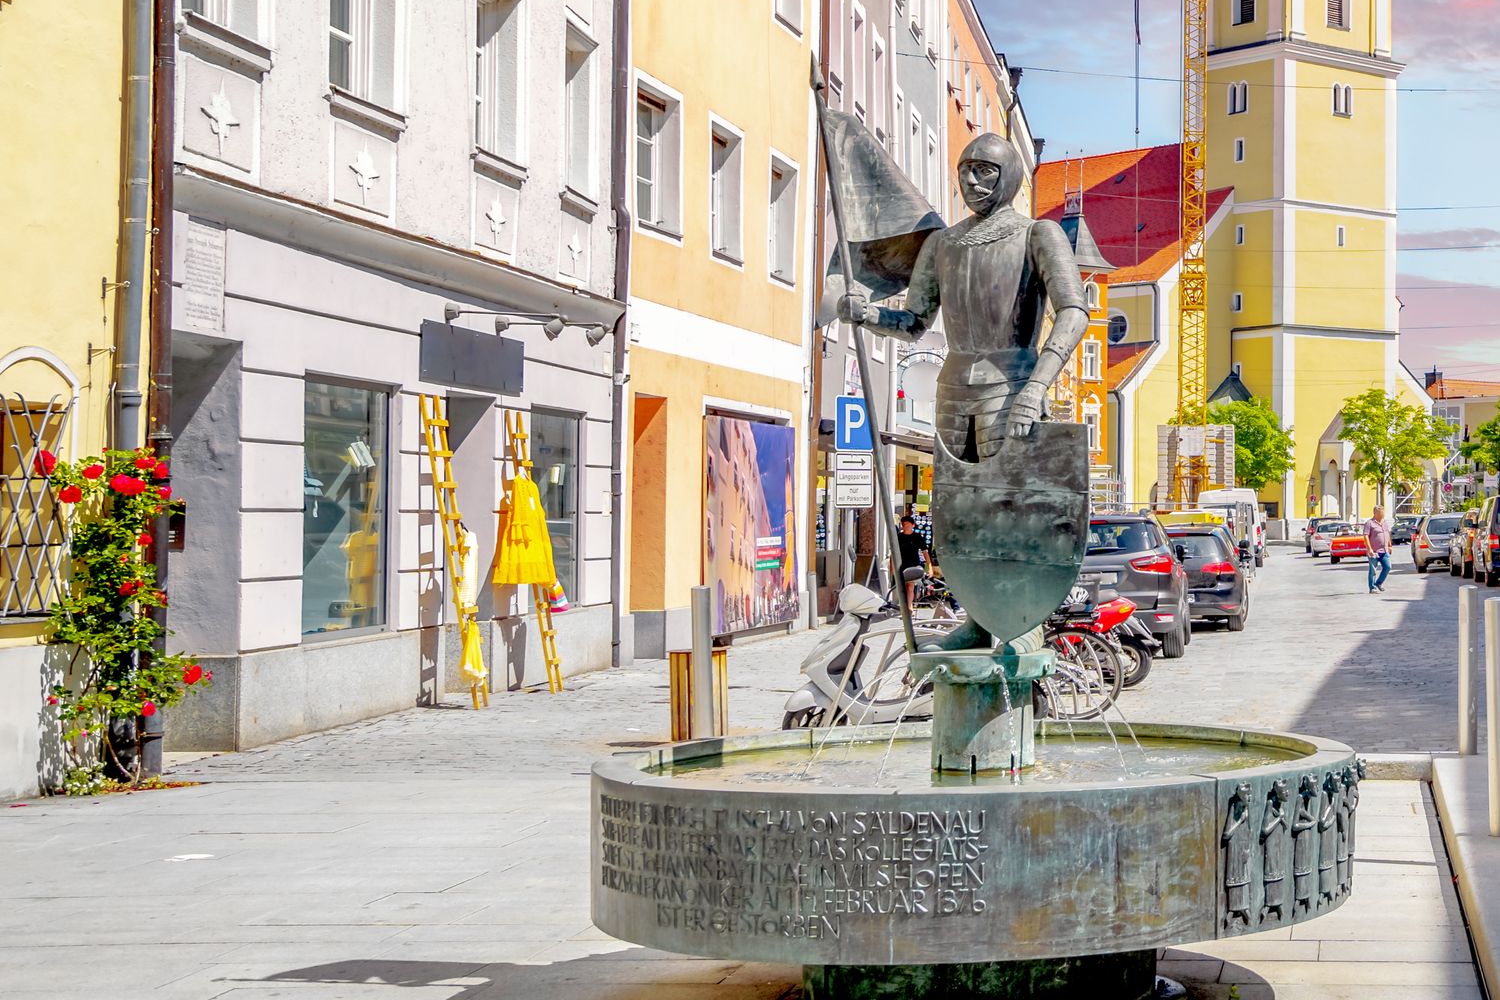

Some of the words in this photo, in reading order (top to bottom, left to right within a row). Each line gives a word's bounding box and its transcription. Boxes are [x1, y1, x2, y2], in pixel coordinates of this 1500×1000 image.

[845, 403, 866, 444] P
[797, 810, 847, 835] VON
[852, 809, 987, 835] SÄLDENAU
[809, 837, 848, 861] DAS
[852, 836, 989, 862] KOLLEGIATS-
[813, 863, 837, 887] IN
[841, 862, 986, 888] VILSHOFEN
[652, 877, 755, 911] KANONIKER
[760, 886, 793, 912] AM
[824, 888, 929, 914] FEBRUAR
[936, 888, 987, 914] 1376
[657, 904, 683, 929] IST
[683, 905, 706, 931] ER
[709, 908, 841, 939] GESTORBEN
